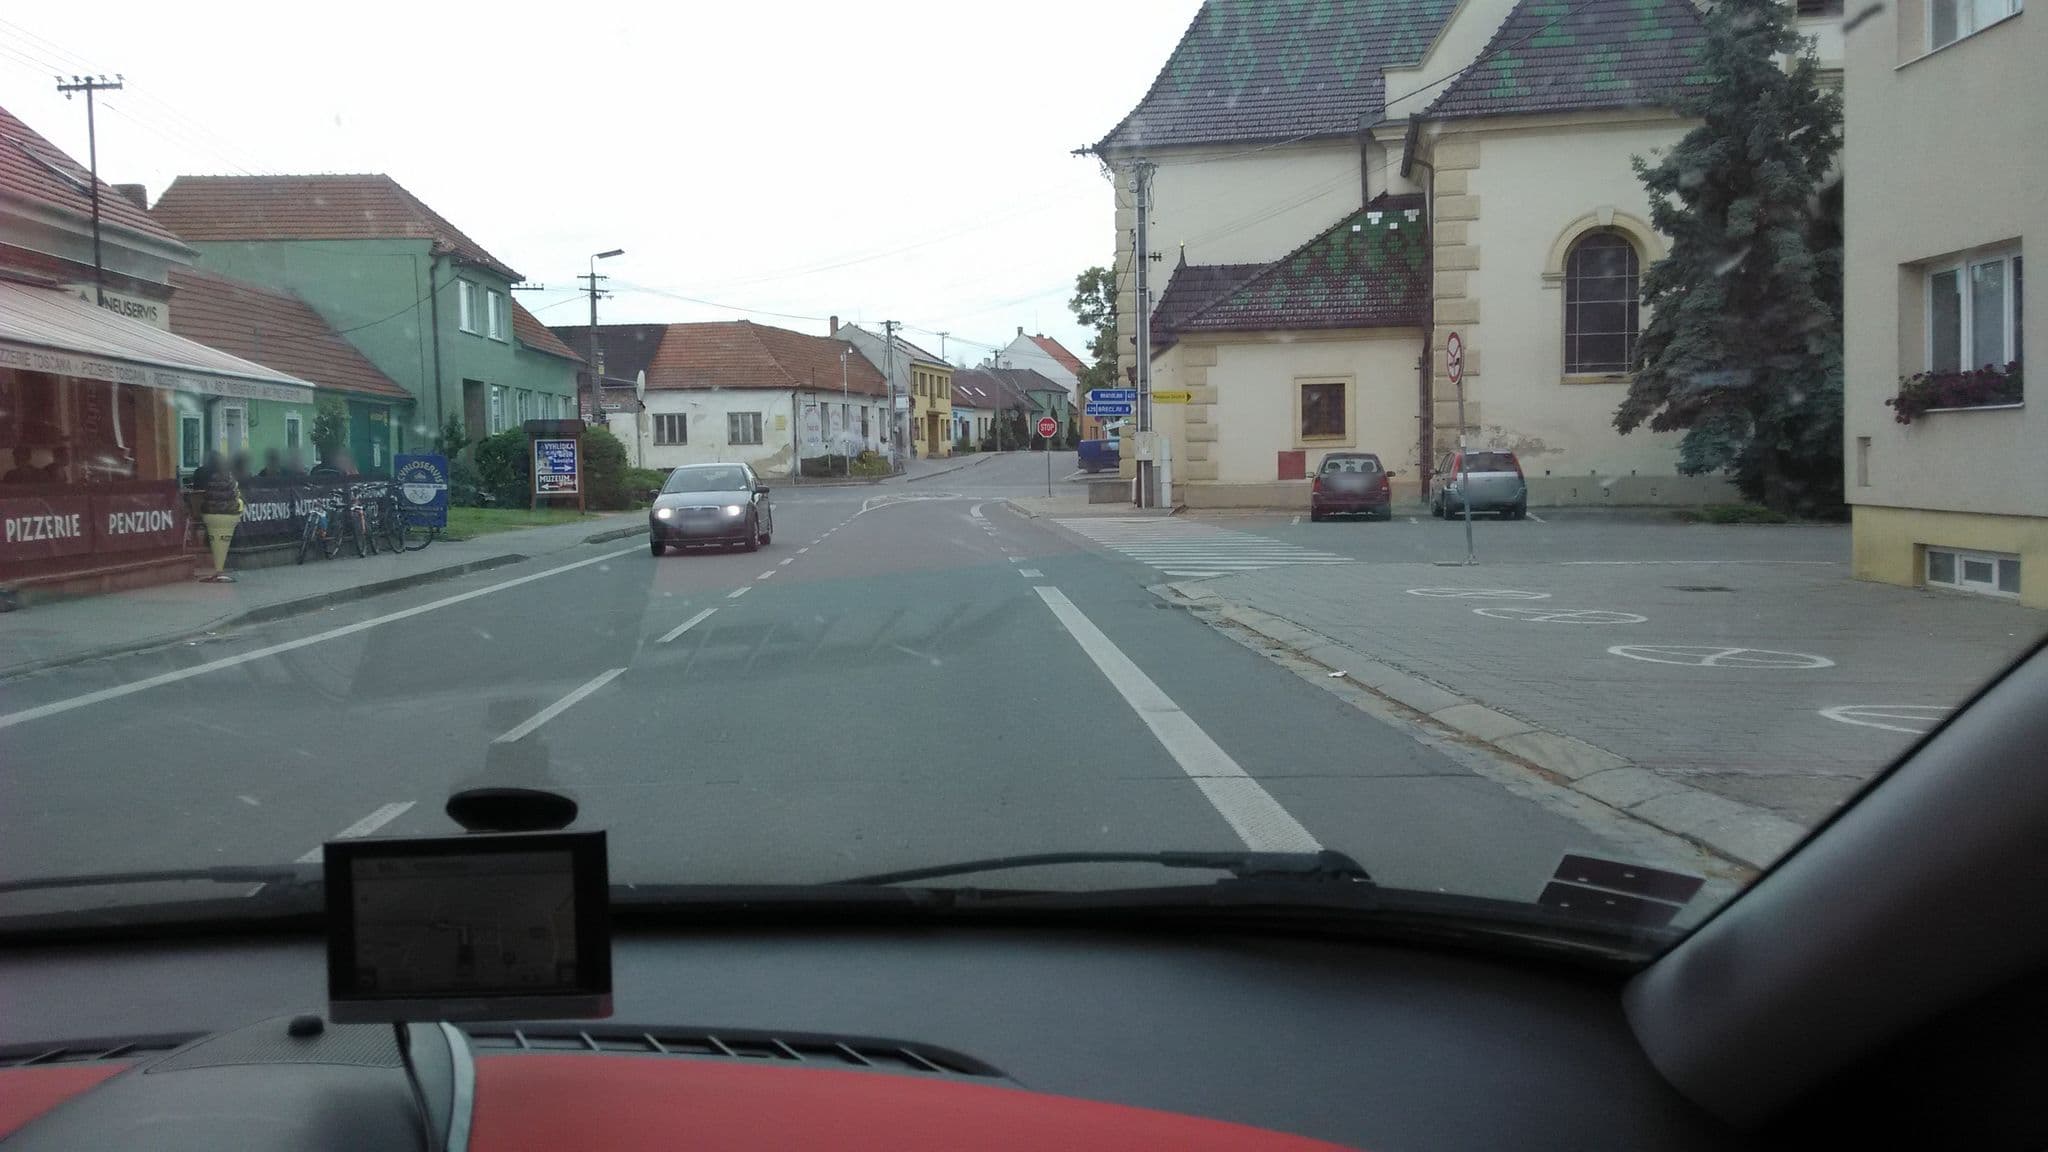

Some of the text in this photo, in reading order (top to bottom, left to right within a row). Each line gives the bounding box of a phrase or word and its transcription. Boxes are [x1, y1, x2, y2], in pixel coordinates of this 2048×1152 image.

[99, 292, 158, 322] NEUSERVIS
[0, 349, 31, 366] ZZERIE
[1040, 423, 1054, 431] STOP
[540, 475, 570, 483] MUZEUM
[241, 502, 290, 523] NEUSERVIS
[5, 509, 173, 543] PIZZERIE PENZION
